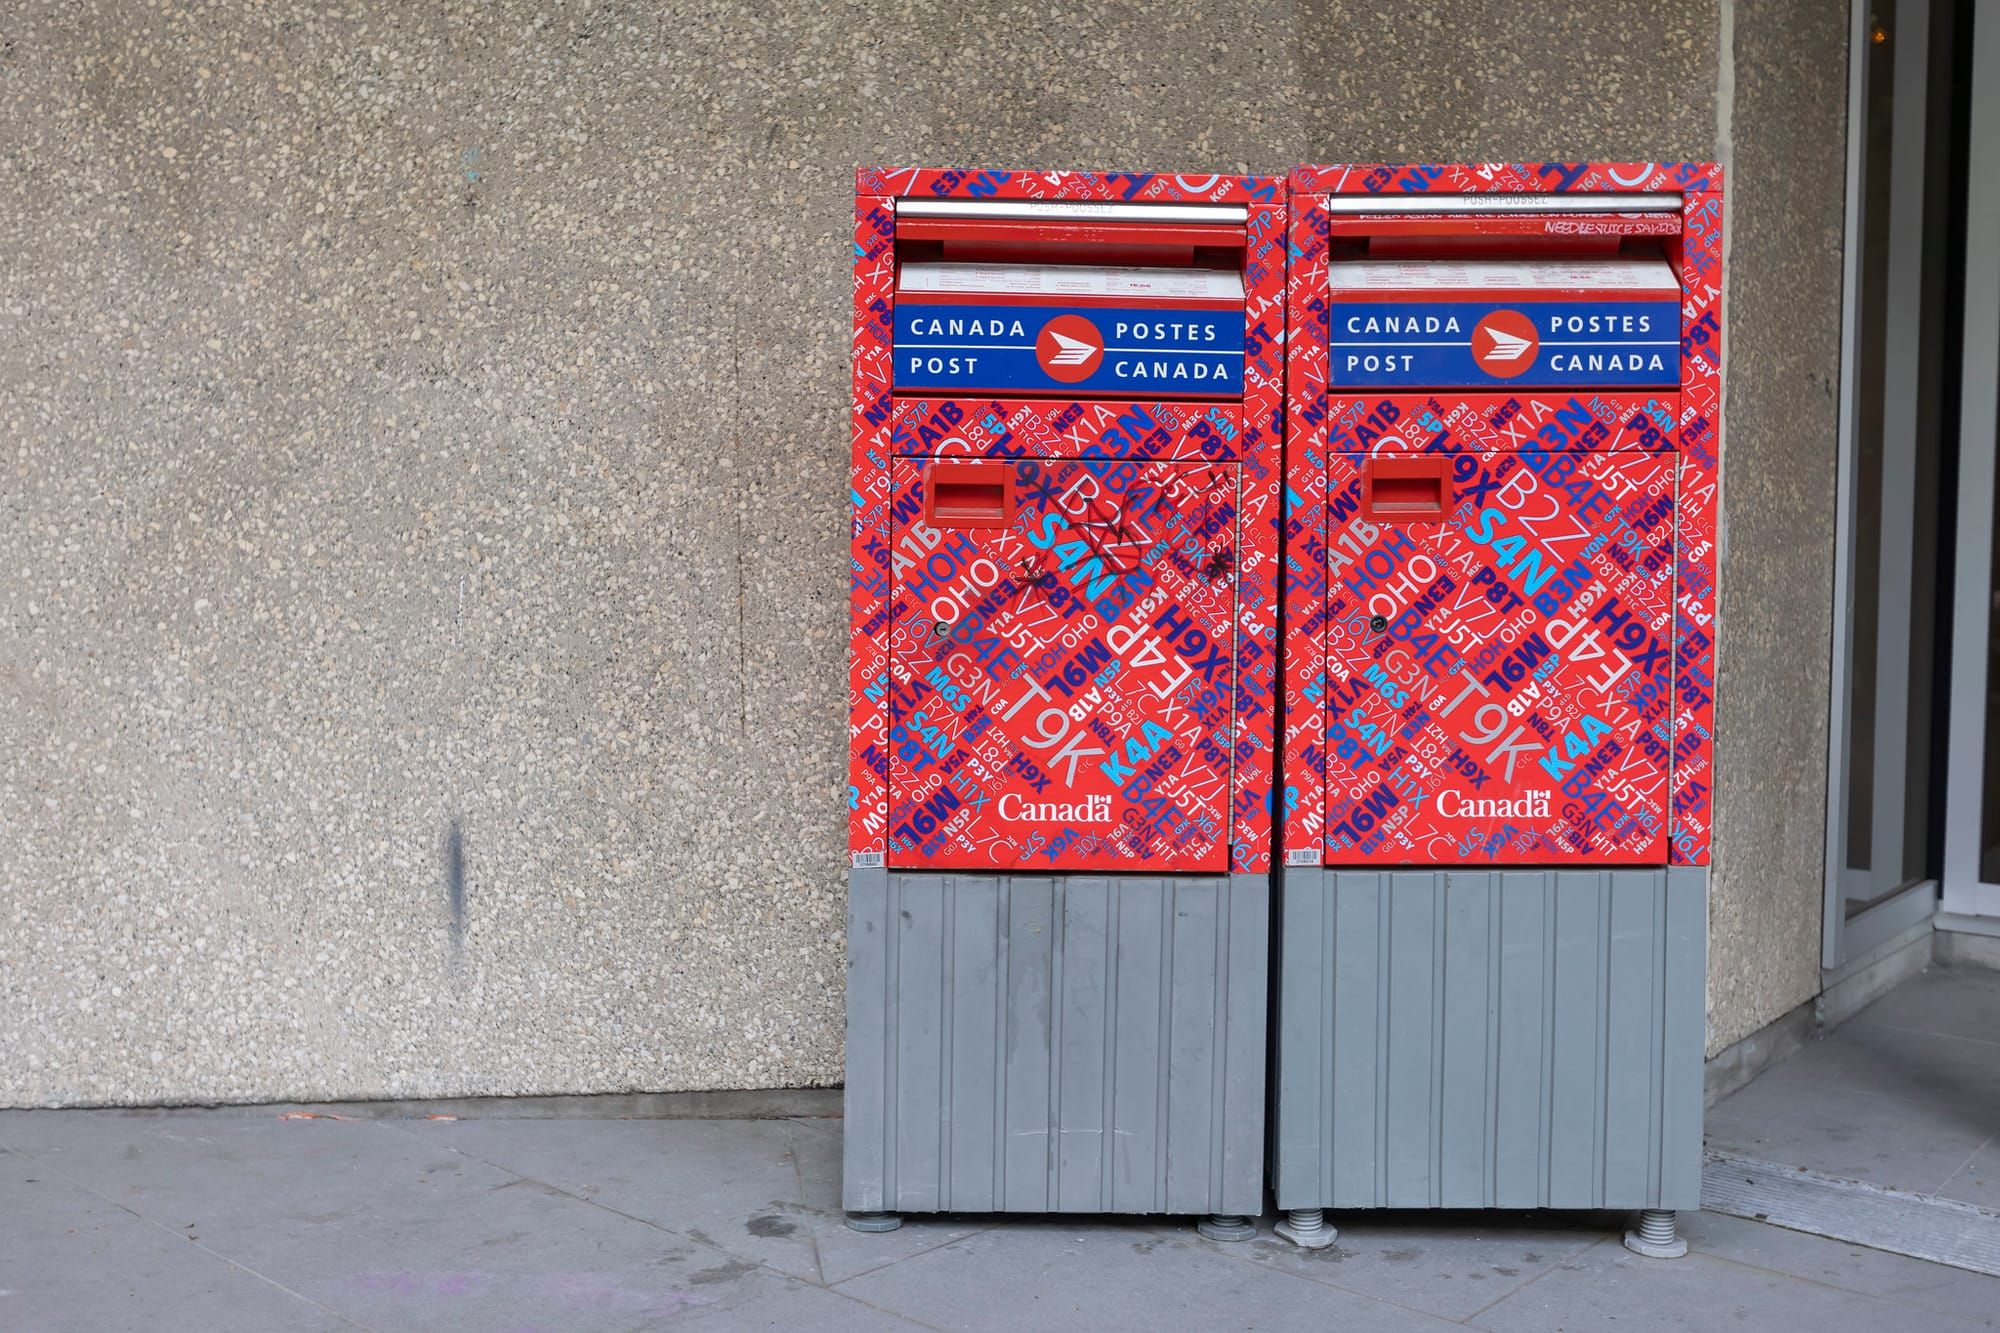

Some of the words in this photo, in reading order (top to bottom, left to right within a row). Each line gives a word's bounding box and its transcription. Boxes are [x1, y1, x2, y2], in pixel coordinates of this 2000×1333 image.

[1210, 180, 1234, 202] K6H
[1688, 198, 1720, 236] S7P
[911, 319, 1025, 336] CANADA
[1116, 322, 1216, 341] POSTES
[1347, 316, 1460, 334] CANADA
[1551, 316, 1650, 333] POSTES
[911, 358, 978, 374] POST
[1115, 361, 1228, 380] CANADA
[1347, 356, 1414, 372] POST
[1550, 355, 1664, 372] CANADA
[1691, 355, 1716, 378] P3Y
[917, 401, 963, 450] A1B
[1025, 414, 1062, 451] B2Z
[1063, 405, 1117, 452] X1A
[1182, 410, 1202, 431] M3C
[1354, 400, 1400, 449] A1B
[1444, 402, 1469, 427] K6H
[1489, 398, 1522, 429] E3N
[1500, 400, 1554, 447] X1A
[1626, 413, 1675, 458] P8T
[1642, 399, 1678, 433] S4N
[1080, 404, 1155, 478] B3N
[1188, 421, 1237, 466] P8T
[1517, 399, 1592, 473] B3N
[1569, 420, 1611, 462] E3N
[1578, 454, 1606, 478] Y1A
[1593, 465, 1638, 501] J5T
[1104, 462, 1174, 531] B4E
[1542, 455, 1612, 524] B4E
[1496, 467, 1590, 563] B2Z
[1632, 494, 1674, 532] M9L
[891, 520, 942, 580] A1B
[1026, 512, 1119, 602] S4N
[1172, 524, 1212, 568] T9K
[1208, 527, 1234, 553] B2J
[1329, 517, 1380, 577] A1B
[1464, 507, 1557, 597] S4N
[1611, 517, 1651, 561] T9K
[1094, 566, 1154, 624] B3N
[1152, 559, 1184, 589] P8T
[1414, 575, 1456, 615] E3N
[1472, 566, 1524, 615] P8T
[1533, 560, 1593, 618] B3N
[1615, 572, 1637, 595] K6H
[1129, 586, 1168, 625] K6H
[1454, 581, 1506, 638] V7J
[1568, 580, 1607, 619] K6H
[1630, 580, 1666, 616] B2Z
[987, 611, 1014, 635] Y1A
[1001, 623, 1046, 658] J5T
[1152, 603, 1230, 682] H9X
[1389, 608, 1458, 678] B4E
[1439, 619, 1484, 654] J5T
[1591, 596, 1669, 675] H9X
[890, 628, 933, 674] B2Z
[951, 612, 1020, 682] B4E
[1044, 637, 1112, 697] M9L
[1106, 623, 1193, 700] E4P
[1328, 625, 1371, 671] B2Z
[1483, 632, 1551, 692] M9L
[1545, 617, 1632, 694] E4P
[924, 666, 972, 712] M6S
[948, 653, 1001, 705] G3N
[1094, 659, 1121, 688] N5P
[1104, 686, 1122, 703] P3Y
[1115, 670, 1159, 714] L7C
[1362, 663, 1410, 709] M6S
[1386, 650, 1439, 702] G3N
[1554, 664, 1598, 708] L7C
[1615, 670, 1640, 698] S7P
[1627, 673, 1671, 713] V6K
[922, 696, 968, 740] R7N
[1097, 701, 1132, 739] P9A
[1188, 680, 1232, 720] V6K
[1360, 693, 1406, 737] R7N
[1508, 681, 1541, 716] A1B
[1596, 692, 1640, 741] X1A
[906, 711, 955, 758] S4N
[1001, 673, 1105, 788] T9K
[1157, 698, 1201, 747] X1A
[1344, 708, 1393, 755] S4N
[1440, 668, 1544, 783] T9K
[891, 725, 936, 771] P8T
[1100, 720, 1174, 788] K4A
[1329, 723, 1374, 769] P8T
[1405, 755, 1431, 778] P3Y
[1539, 715, 1613, 783] K4A
[1583, 741, 1621, 776] E3N
[950, 769, 990, 813] H1X
[1010, 752, 1052, 794] H9X
[1154, 775, 1179, 795] Y1A
[1388, 766, 1428, 810] H1X
[1449, 748, 1491, 790] H9X
[1621, 746, 1665, 794] V7J
[862, 786, 886, 807] Y1A
[894, 785, 962, 846] M9L
[998, 793, 1112, 822] Canada
[1122, 775, 1184, 837] B4E
[1168, 785, 1207, 815] J5T
[1332, 782, 1400, 843] M9L
[1437, 789, 1551, 818] Canada
[1562, 770, 1624, 832] B4E
[965, 815, 1014, 864] L7C
[1122, 807, 1157, 842] G3N
[1381, 805, 1408, 834] N5P
[1395, 831, 1416, 850] P3Y
[1404, 812, 1453, 861] L7C
[1620, 831, 1641, 850] T1C
[1633, 804, 1663, 837] T9K
[1683, 812, 1704, 834] M3C
[1152, 837, 1177, 862] H1T
[1555, 837, 1573, 854] N5P
[1633, 836, 1653, 855] T4H
